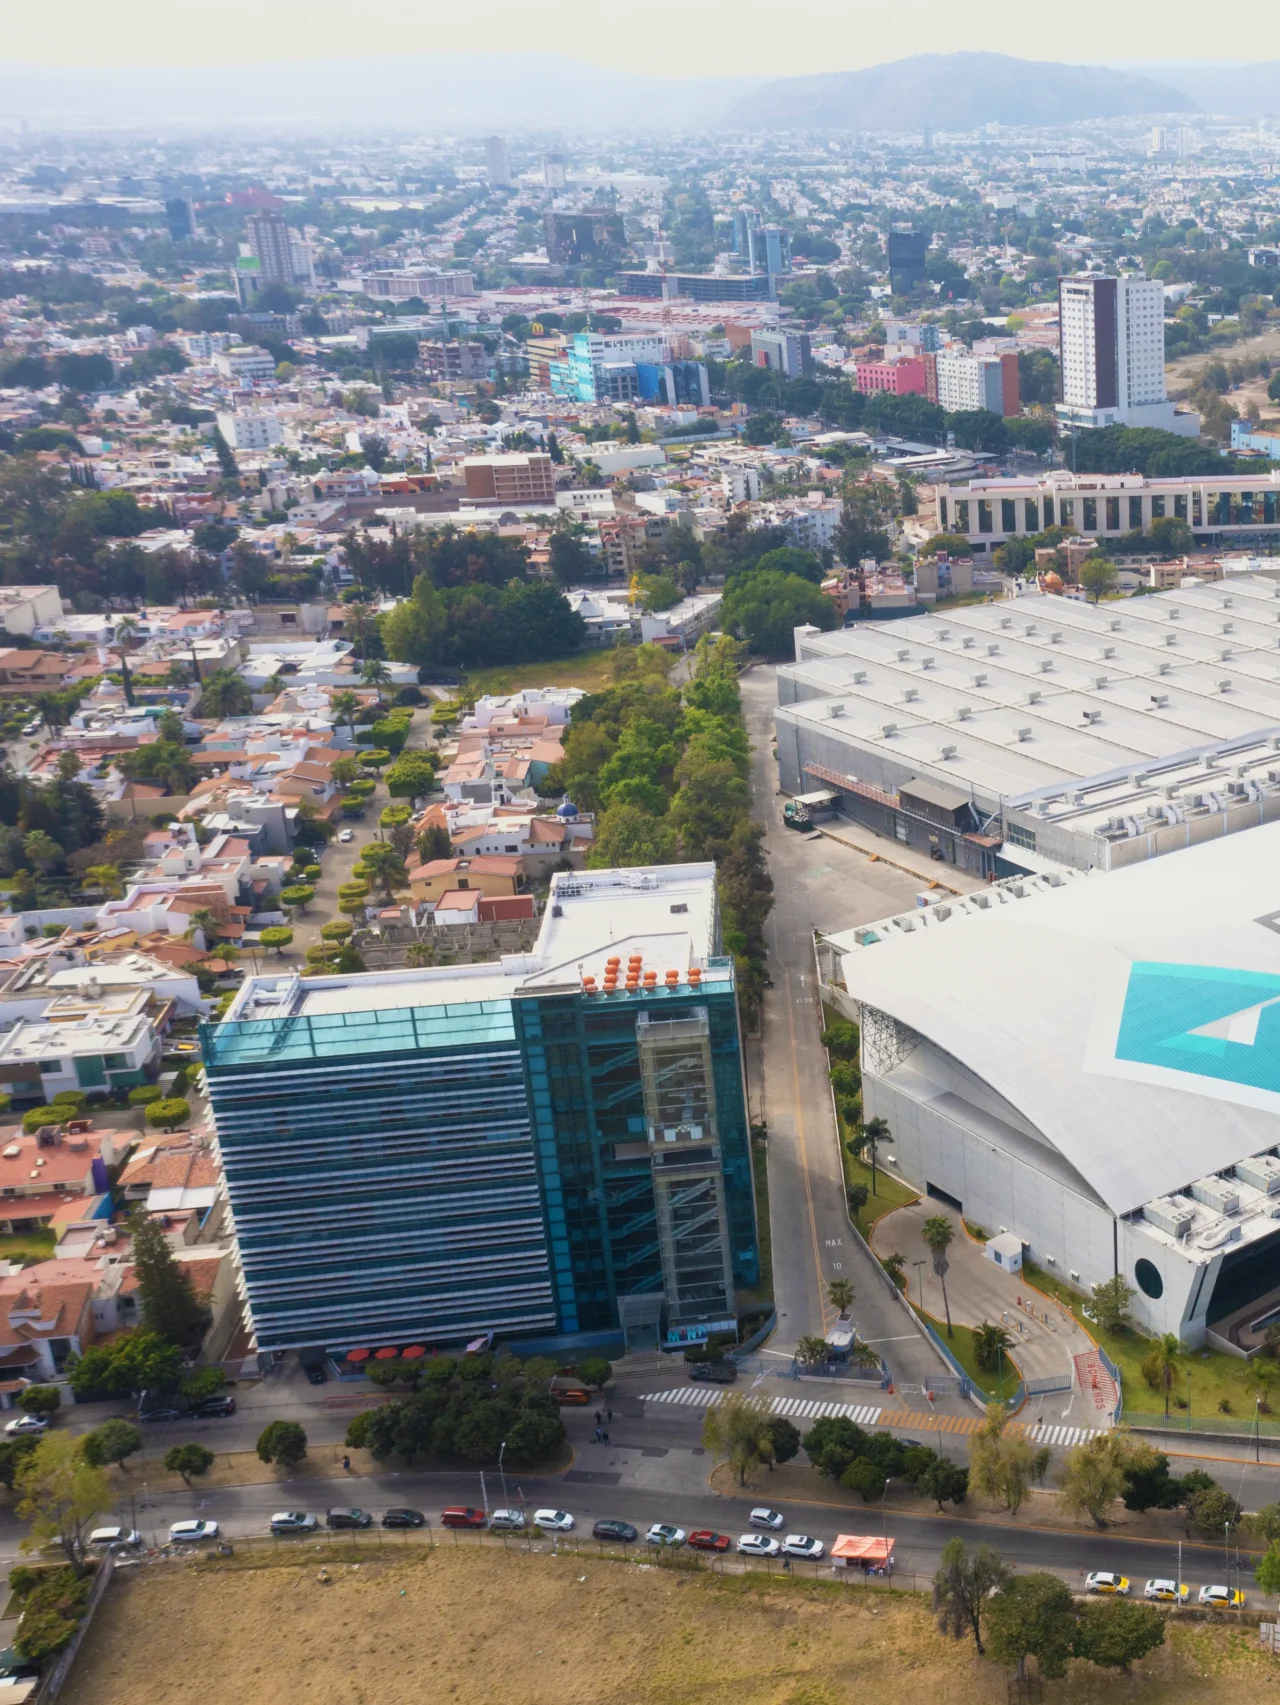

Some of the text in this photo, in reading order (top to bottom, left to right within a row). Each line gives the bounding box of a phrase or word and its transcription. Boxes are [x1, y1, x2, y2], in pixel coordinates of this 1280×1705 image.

[825, 1238, 842, 1247] MAX
[833, 1262, 842, 1270] 10
[1087, 1363, 1106, 1410] BOEROS
